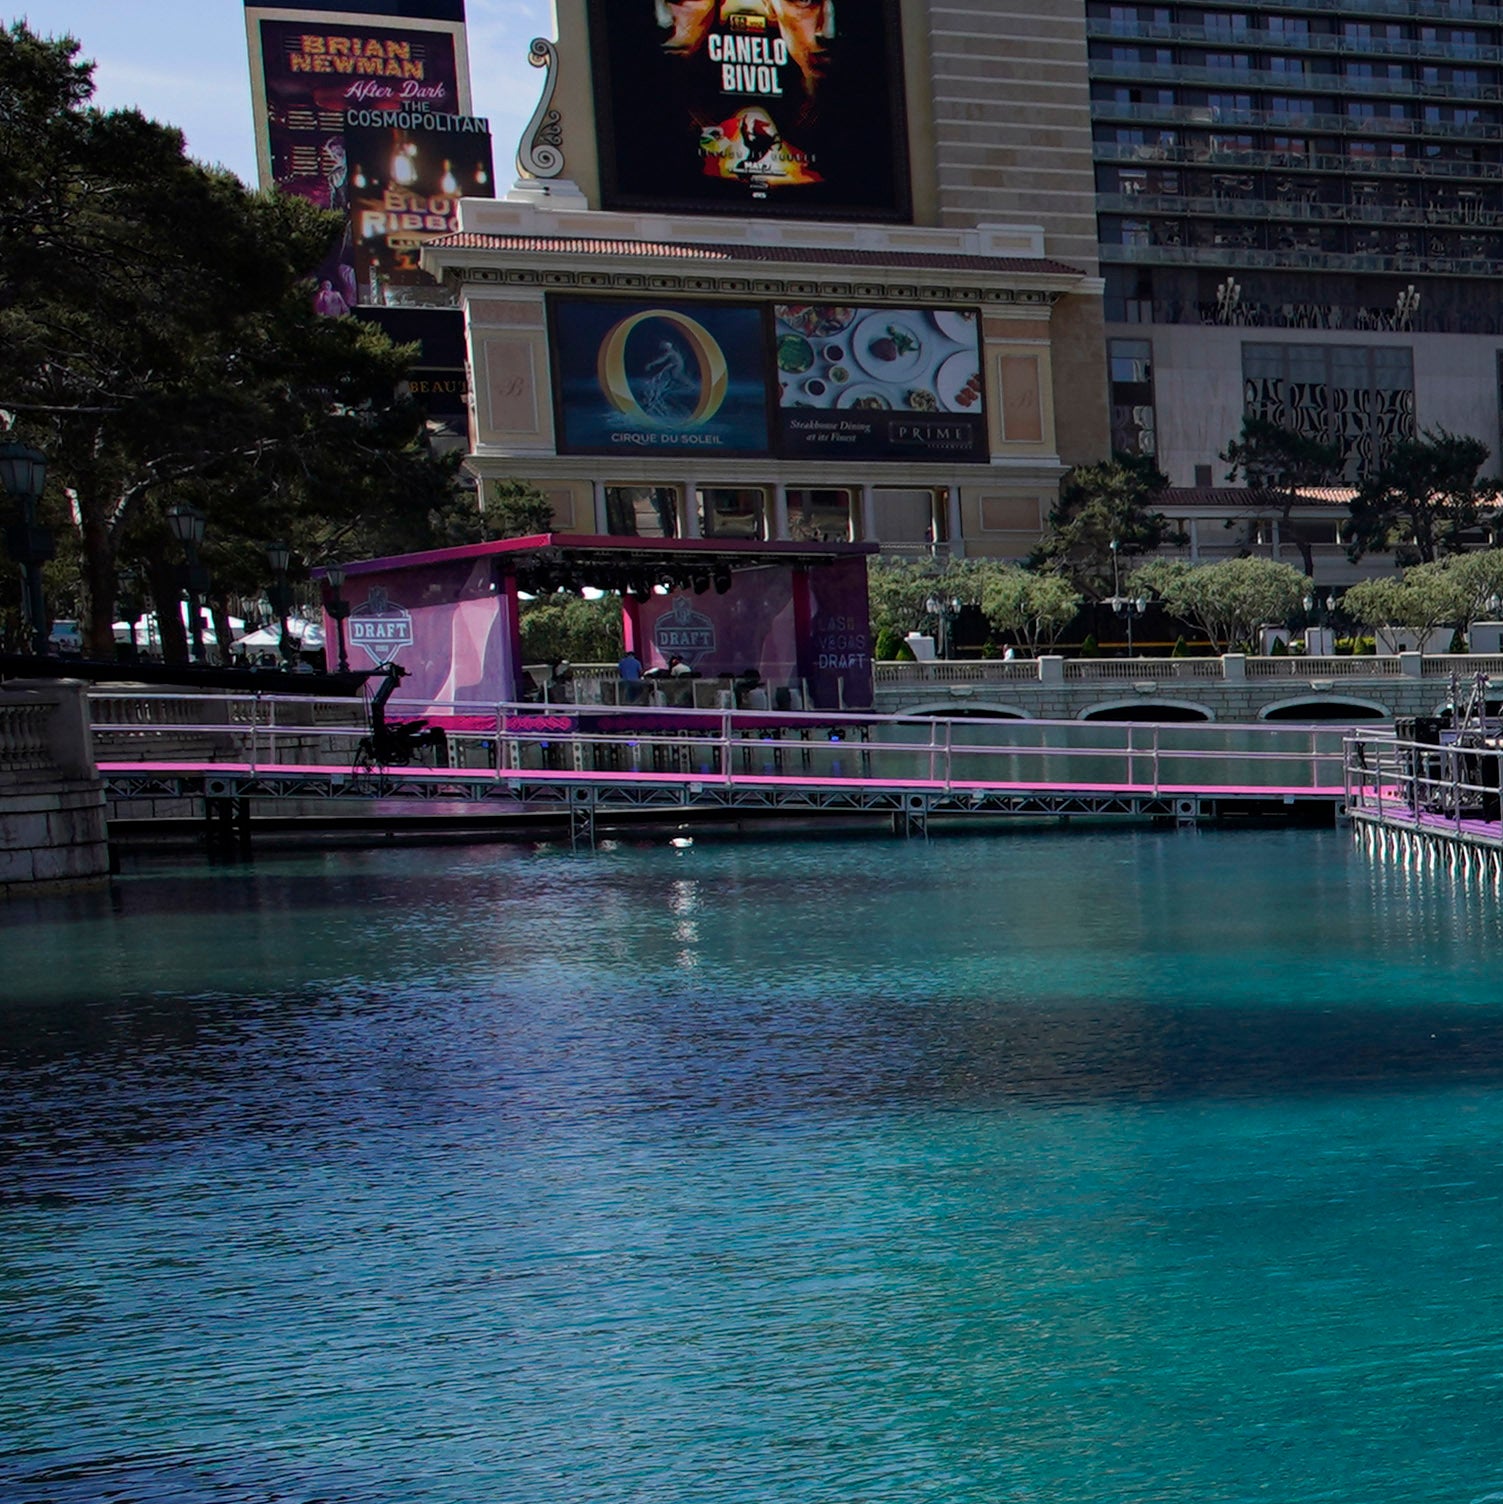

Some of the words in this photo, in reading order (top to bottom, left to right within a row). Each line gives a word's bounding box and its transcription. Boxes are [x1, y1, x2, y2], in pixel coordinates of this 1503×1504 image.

[300, 34, 411, 60] BRIAN
[708, 33, 788, 66] CANELO
[289, 52, 424, 81] NEWMAN
[721, 63, 784, 94] BIVOL
[343, 79, 394, 102] After
[400, 79, 447, 99] Dark
[402, 100, 430, 114] THE
[346, 109, 488, 134] COSMOPOLITAN
[384, 189, 457, 217] BLU
[790, 419, 838, 431] Steakhouse
[840, 420, 871, 434] Dining
[899, 425, 962, 443] PRIME
[611, 431, 658, 446] CIRQUE
[661, 433, 679, 445] DU
[681, 433, 724, 446] SOLEIL
[831, 432, 857, 443] Finest
[354, 623, 407, 638] DRAFT
[660, 631, 711, 647] DRAFT
[818, 653, 866, 670] DRAFT
